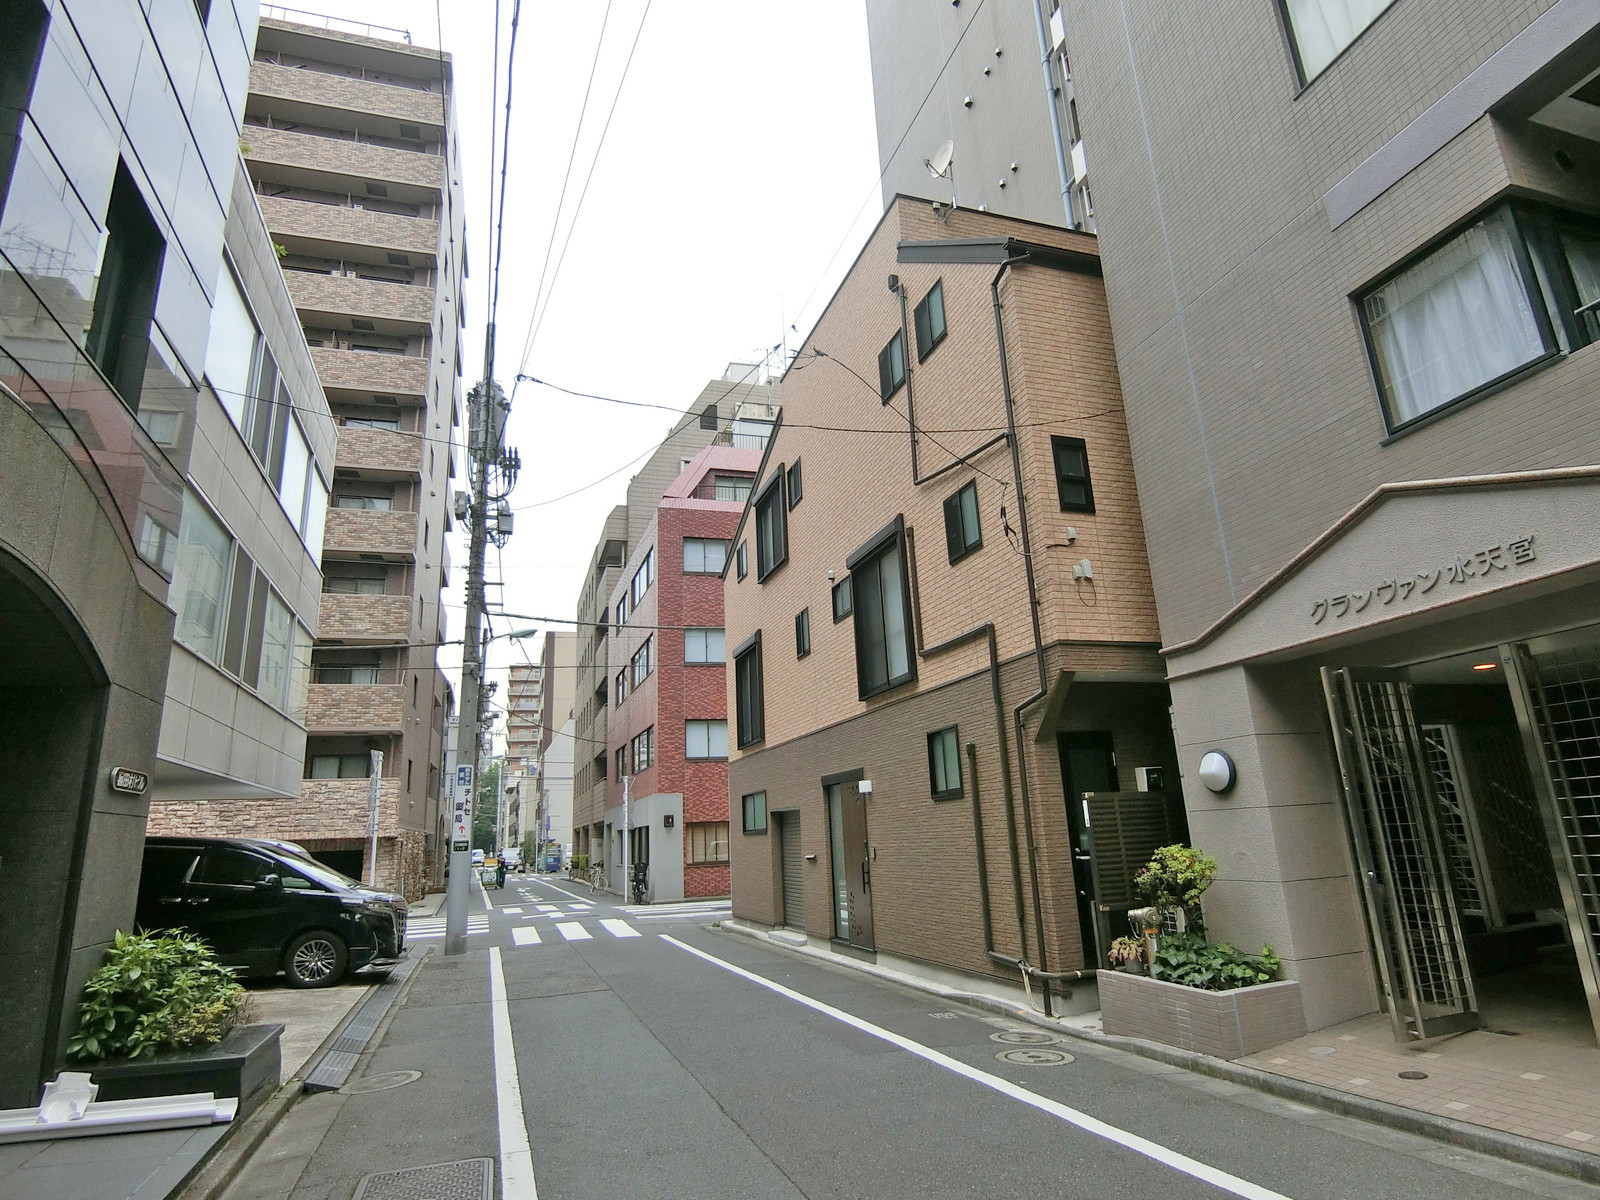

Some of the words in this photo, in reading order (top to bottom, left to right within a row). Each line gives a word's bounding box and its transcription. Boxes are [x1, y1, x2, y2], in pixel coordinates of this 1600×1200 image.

[455, 802, 464, 823] 薬局
[464, 788, 472, 815] チトセ
